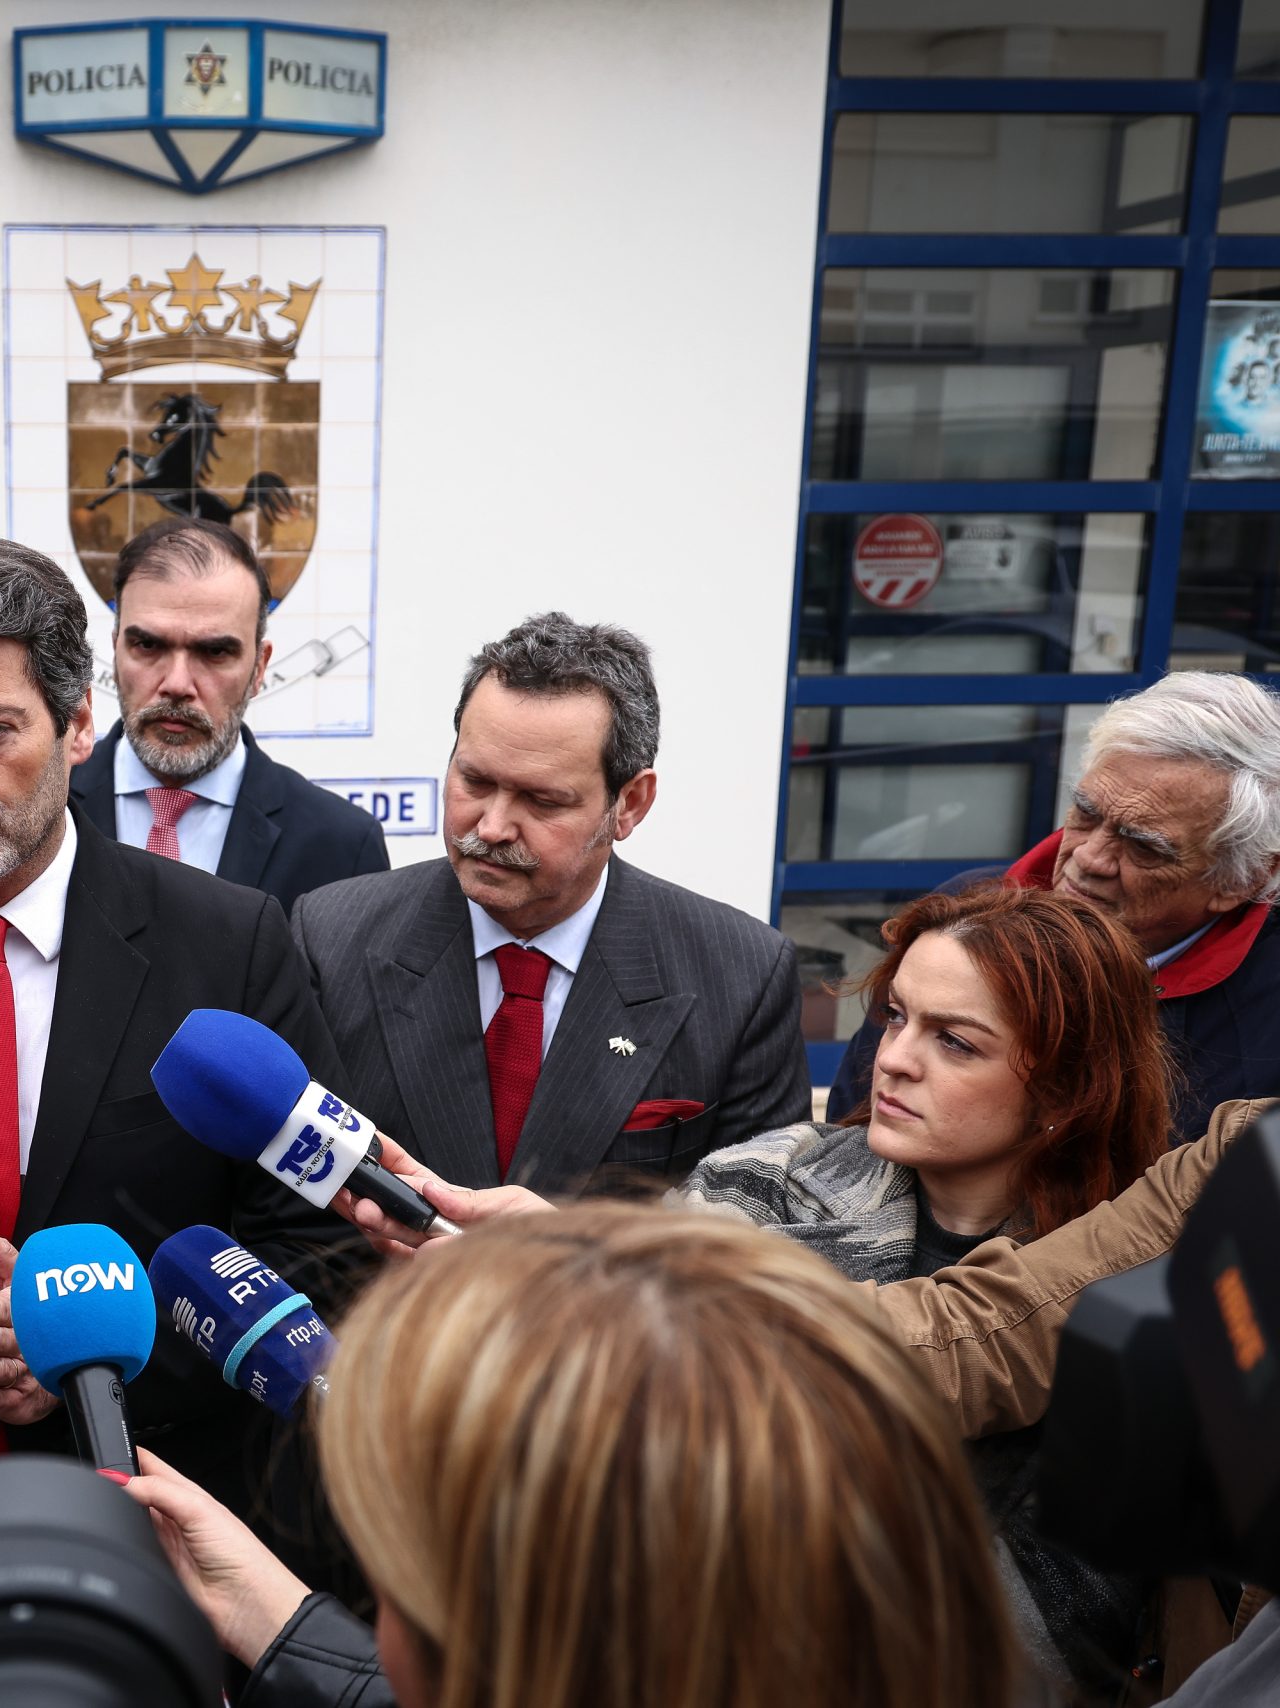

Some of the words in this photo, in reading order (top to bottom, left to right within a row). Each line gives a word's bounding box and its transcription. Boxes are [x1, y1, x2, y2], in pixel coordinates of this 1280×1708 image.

[27, 63, 146, 96] POLICIA
[267, 56, 375, 97] POLICIA
[295, 1165, 313, 1187] RÁDIO
[310, 1136, 335, 1167] NOTÍCIAS
[228, 1268, 280, 1305] RTP
[195, 1316, 217, 1359] TP
[285, 1316, 324, 1347] rtp.pt
